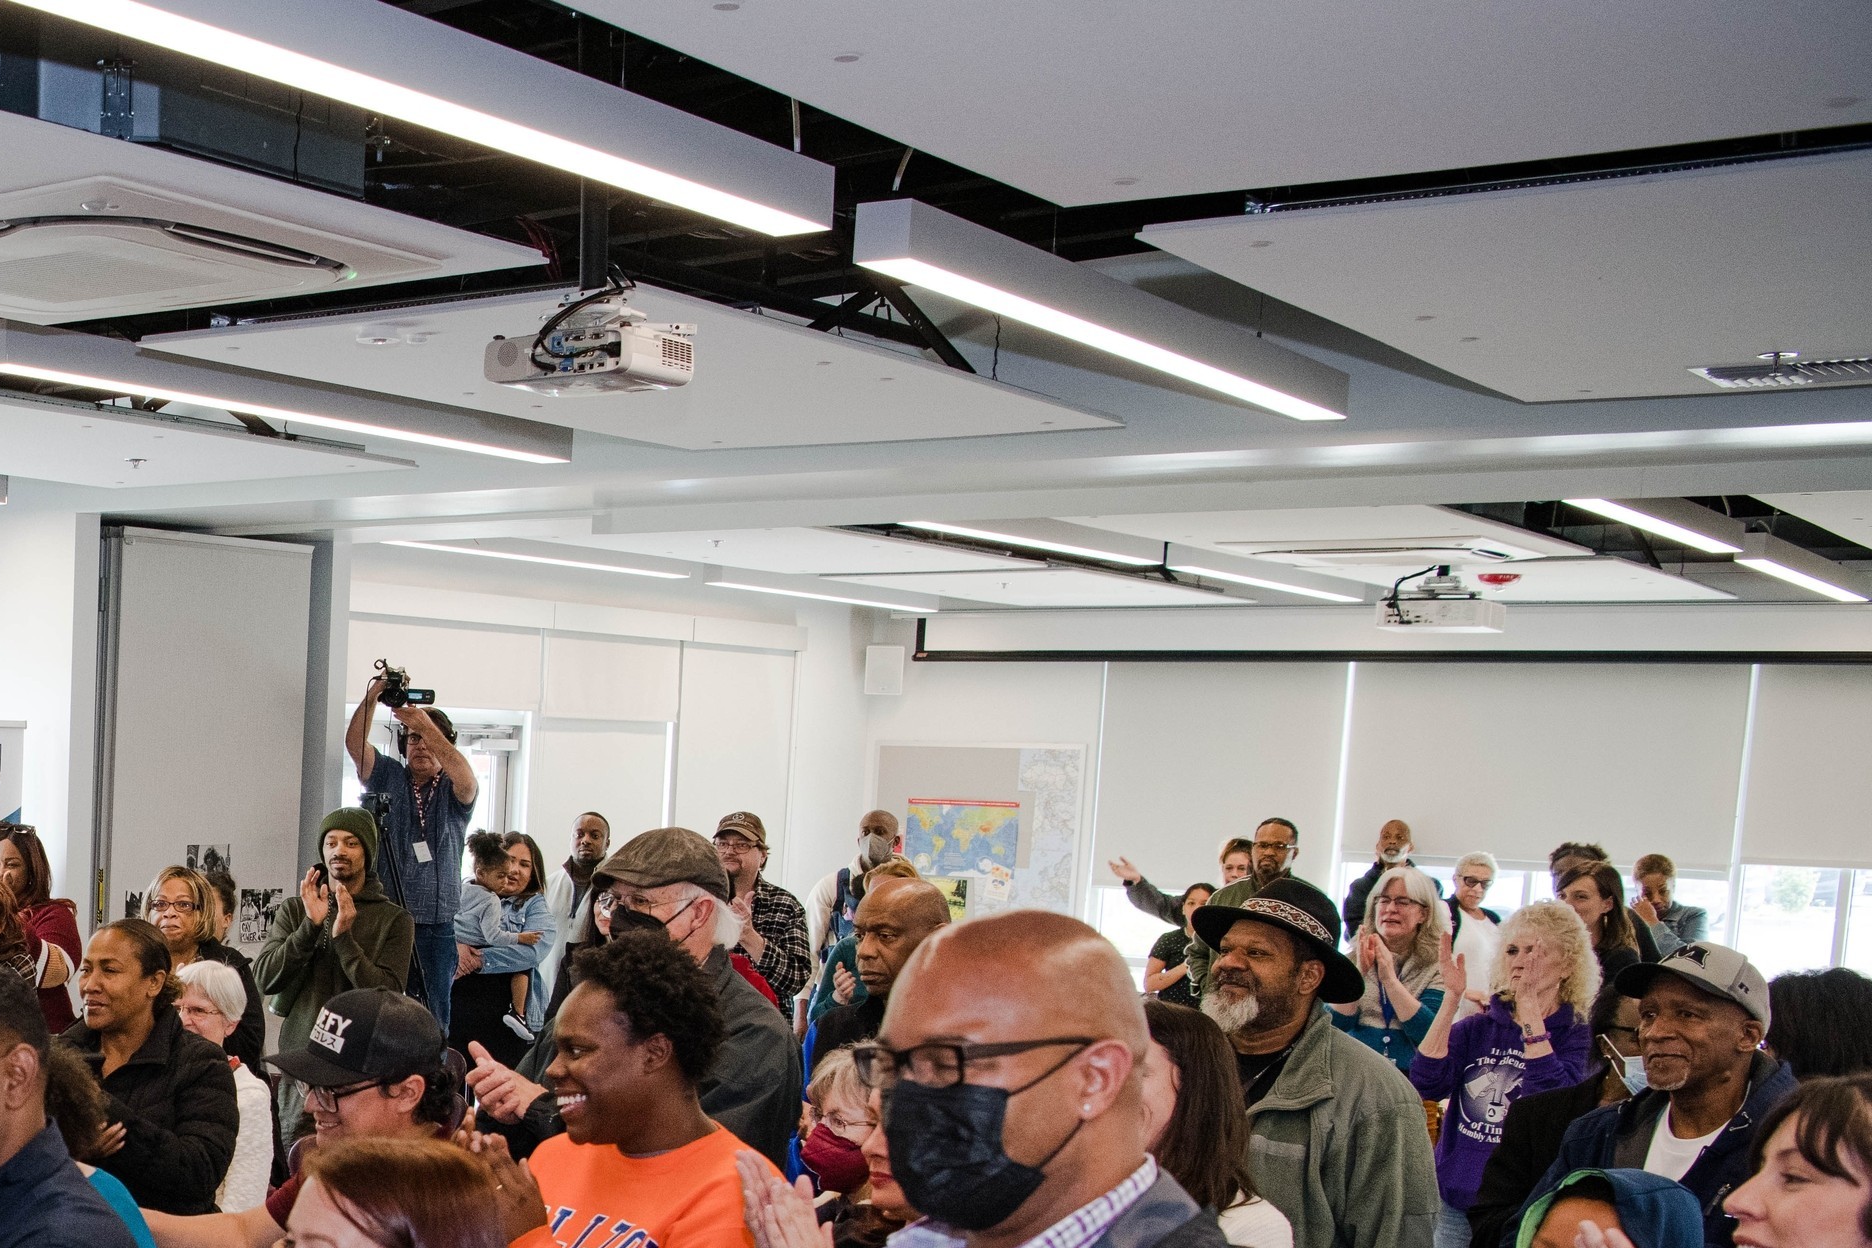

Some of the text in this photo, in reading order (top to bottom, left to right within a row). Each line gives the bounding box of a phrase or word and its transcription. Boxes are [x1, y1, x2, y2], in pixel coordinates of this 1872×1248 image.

[312, 1027, 337, 1049] ロレス
[1476, 1056, 1497, 1066] The
[1471, 1121, 1484, 1132] of
